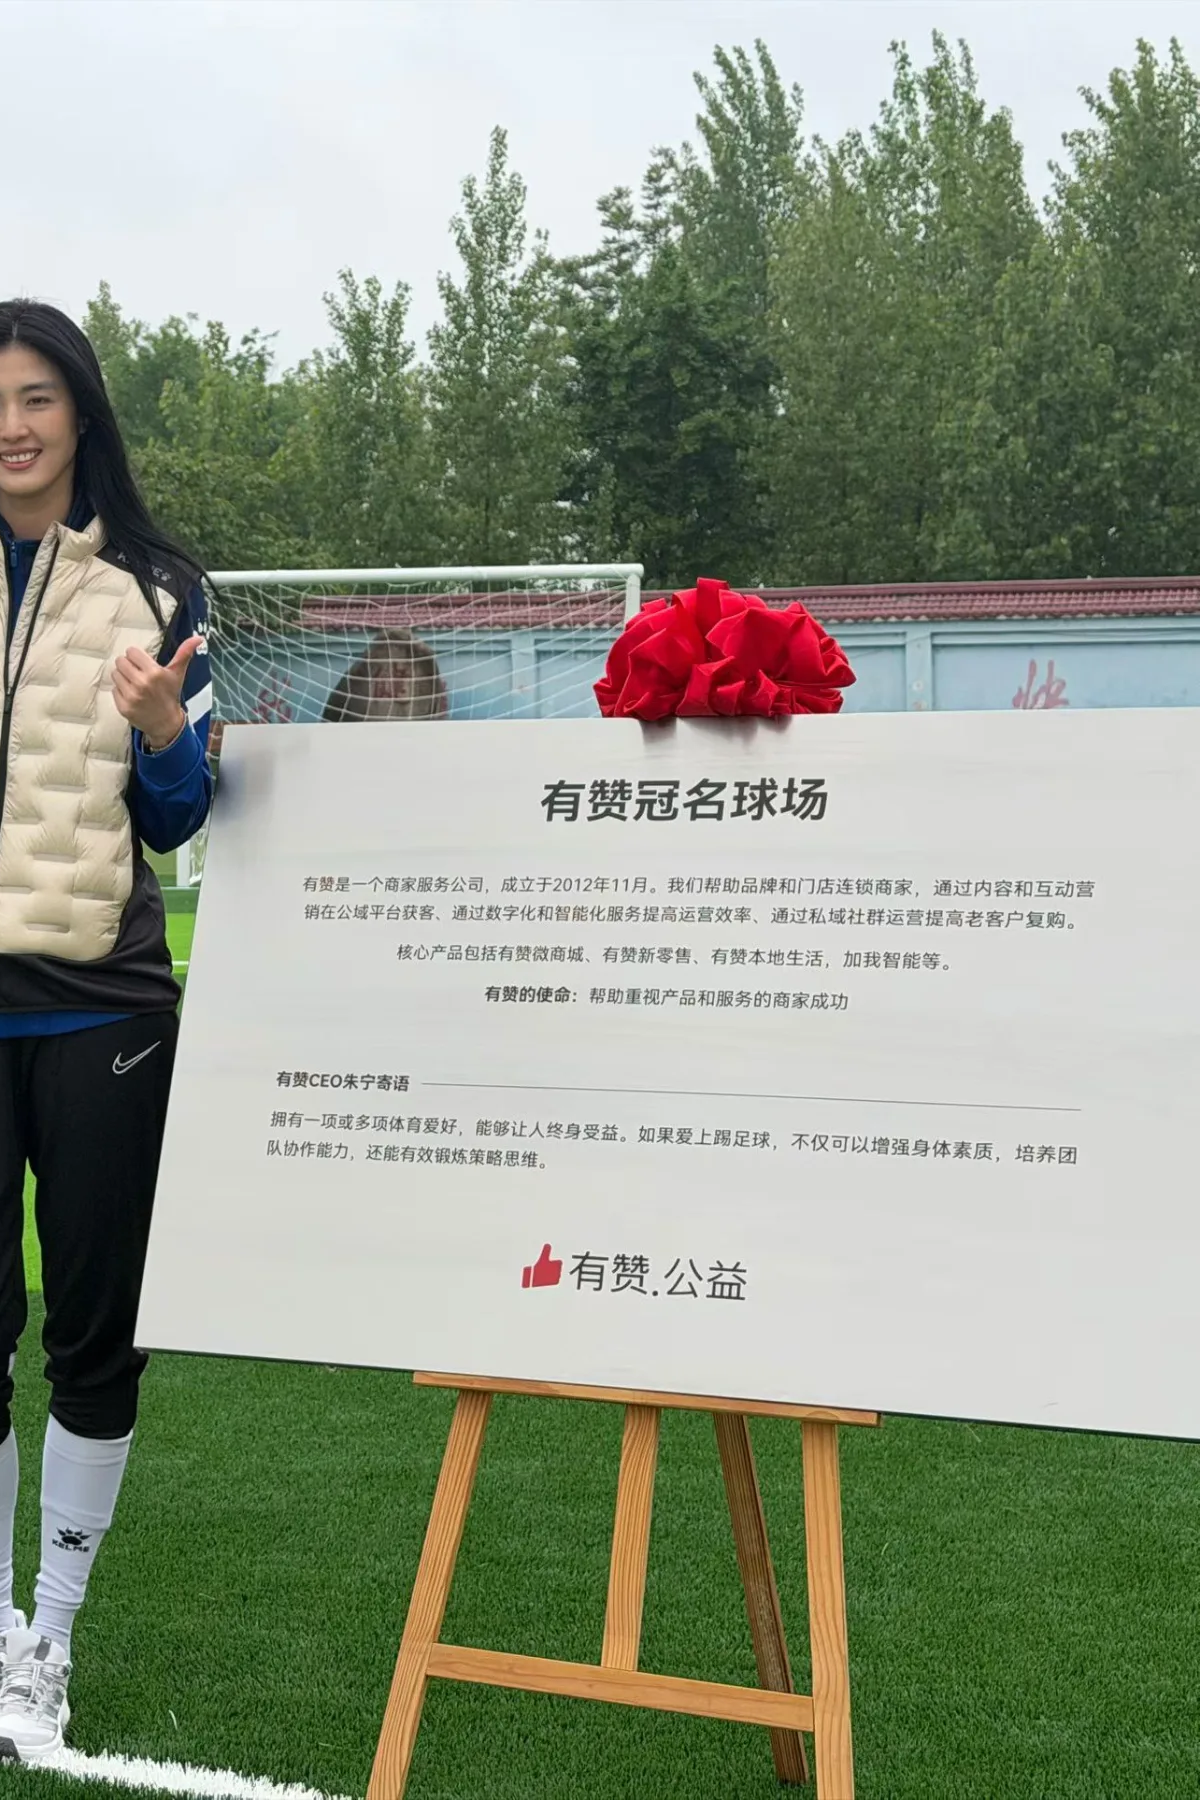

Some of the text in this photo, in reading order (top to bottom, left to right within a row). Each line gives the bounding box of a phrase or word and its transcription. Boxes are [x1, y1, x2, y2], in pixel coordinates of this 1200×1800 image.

[541, 776, 828, 822] 有赞冠名球场
[275, 1070, 410, 1093] 有赞CEO朱宁寄语
[265, 1139, 548, 1171] 队协作能力，还能有效锻炼策略思维。
[52, 1539, 90, 1553] KELME
